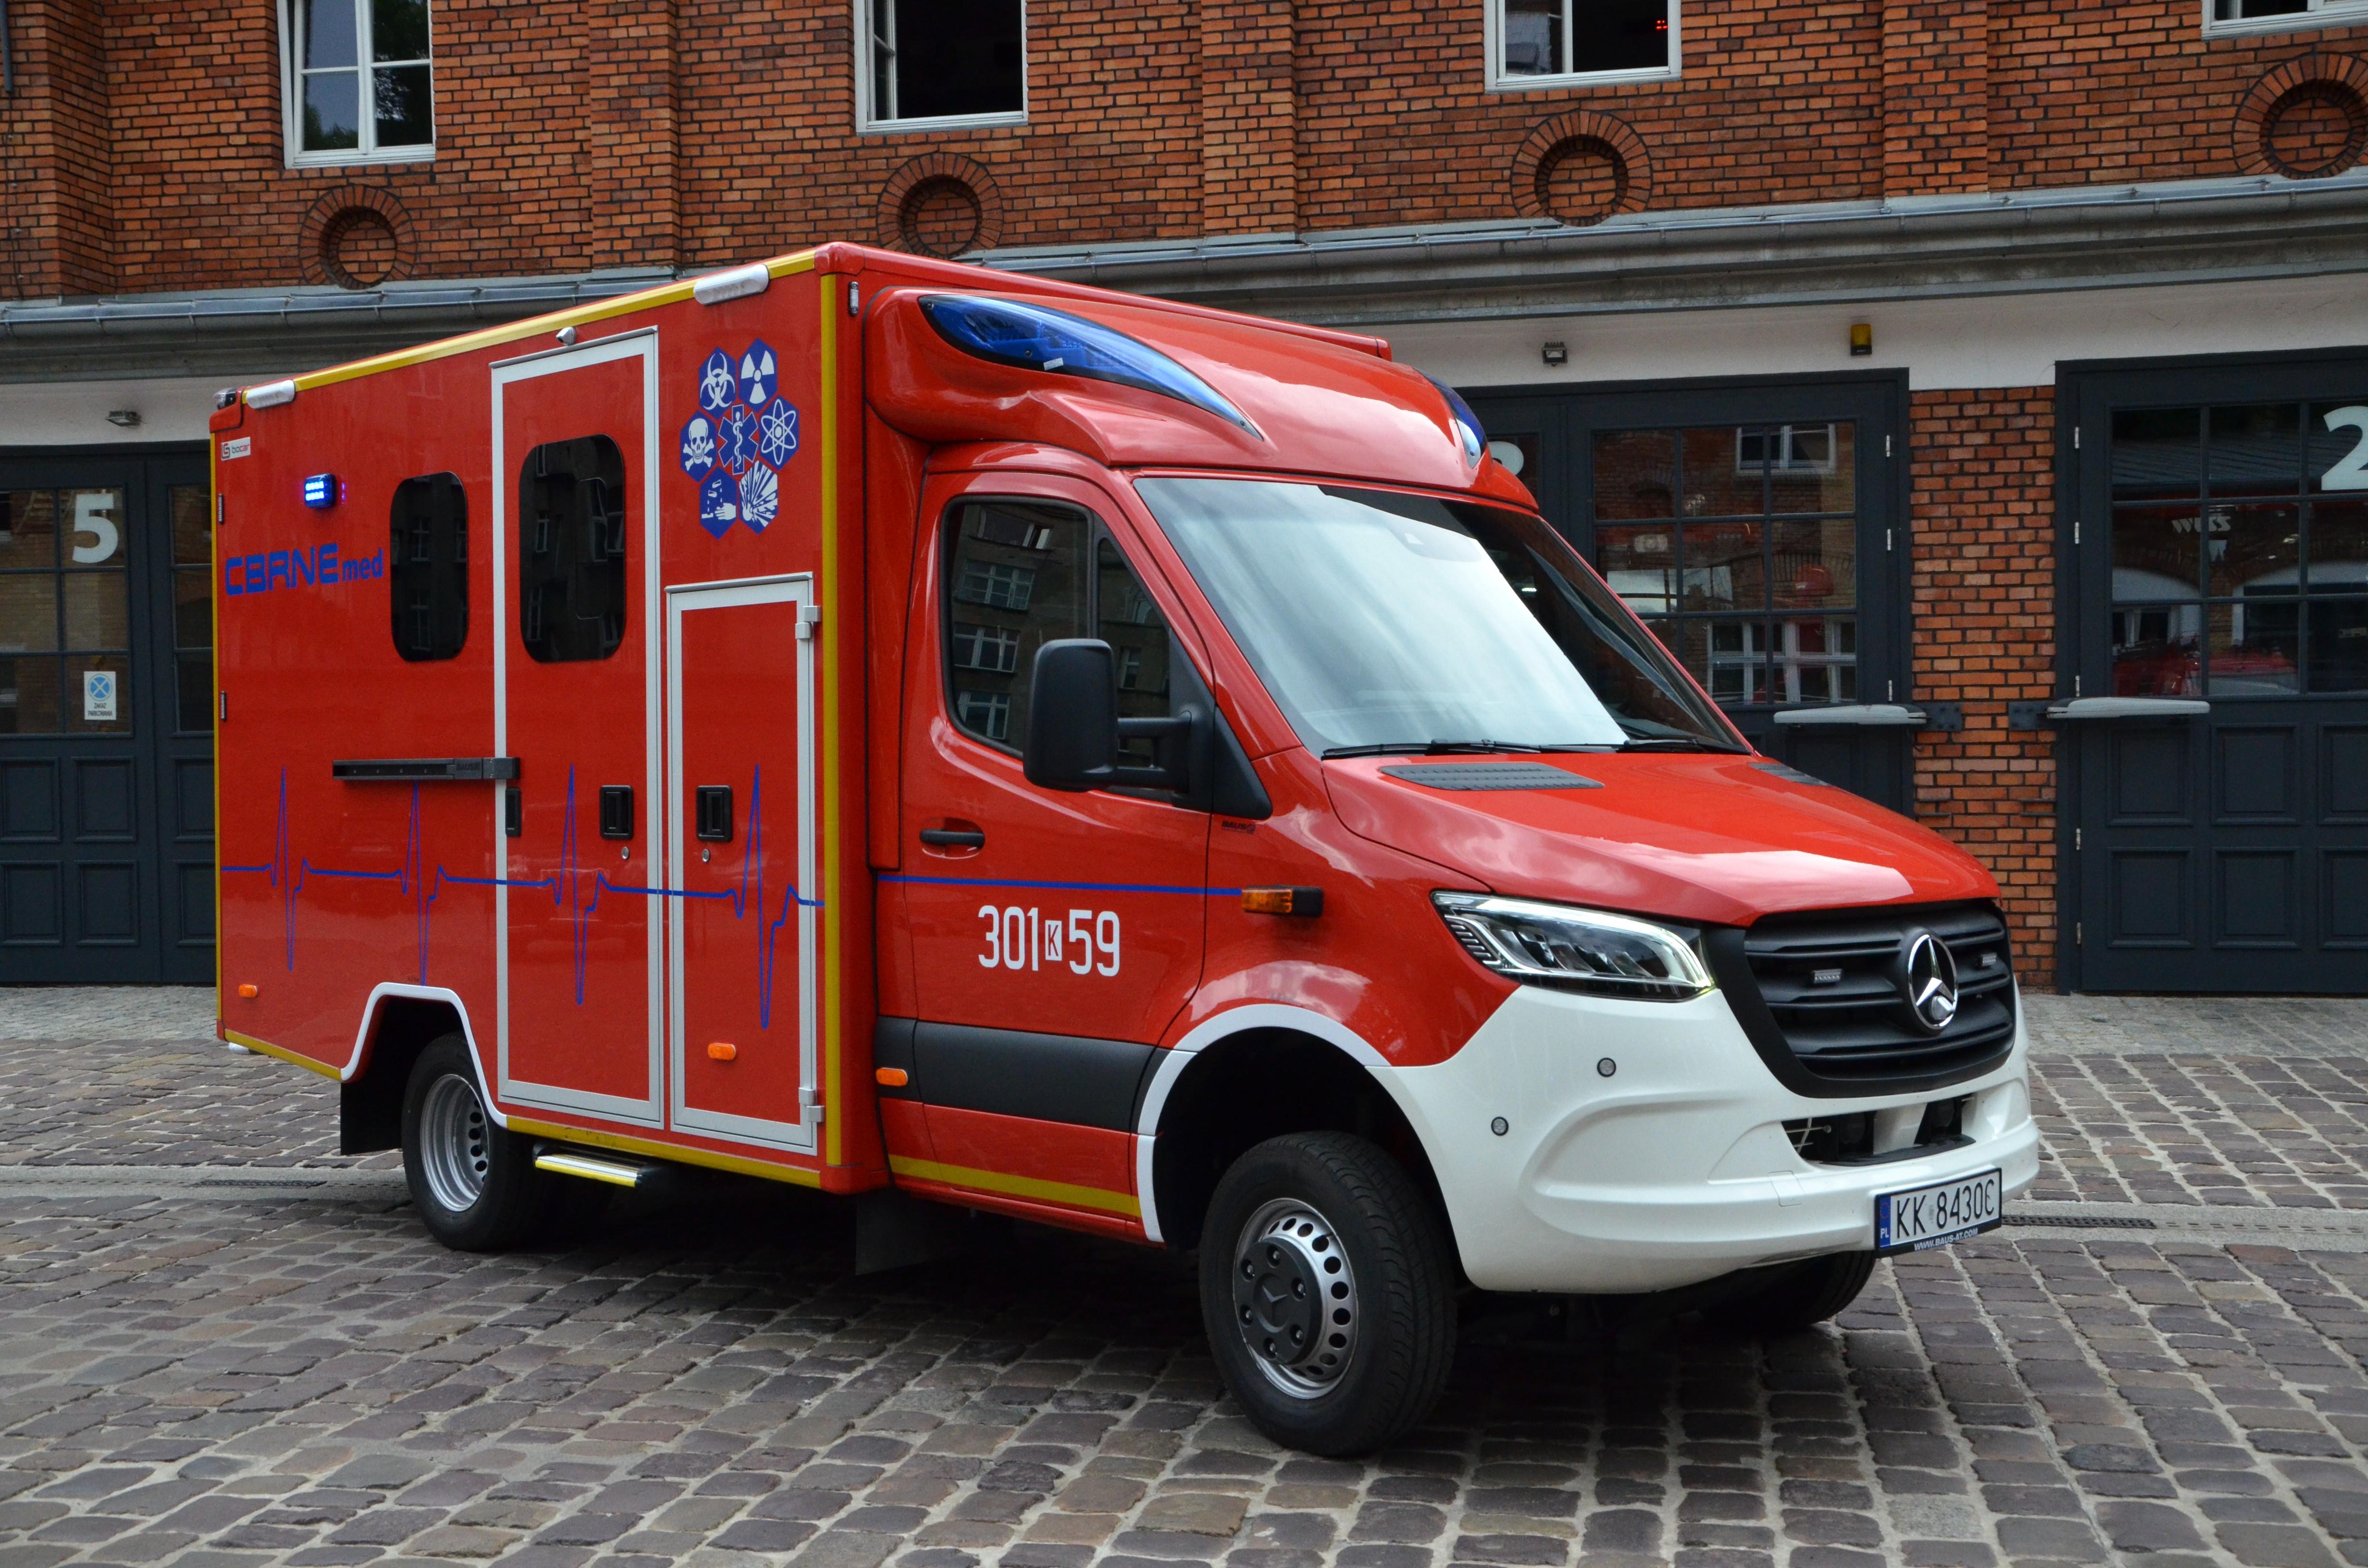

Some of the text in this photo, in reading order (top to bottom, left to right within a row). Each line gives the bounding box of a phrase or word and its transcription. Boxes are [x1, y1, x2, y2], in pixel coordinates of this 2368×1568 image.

[231, 444, 250, 453] bocar
[2321, 405, 2368, 490] 2
[73, 493, 118, 564] 5
[225, 542, 383, 596] CBRNE med
[1880, 1227, 1889, 1239] PL
[1897, 1178, 1995, 1239] KK 8430C
[1914, 1227, 1978, 1251] WWW.BAUS-AT.COM
